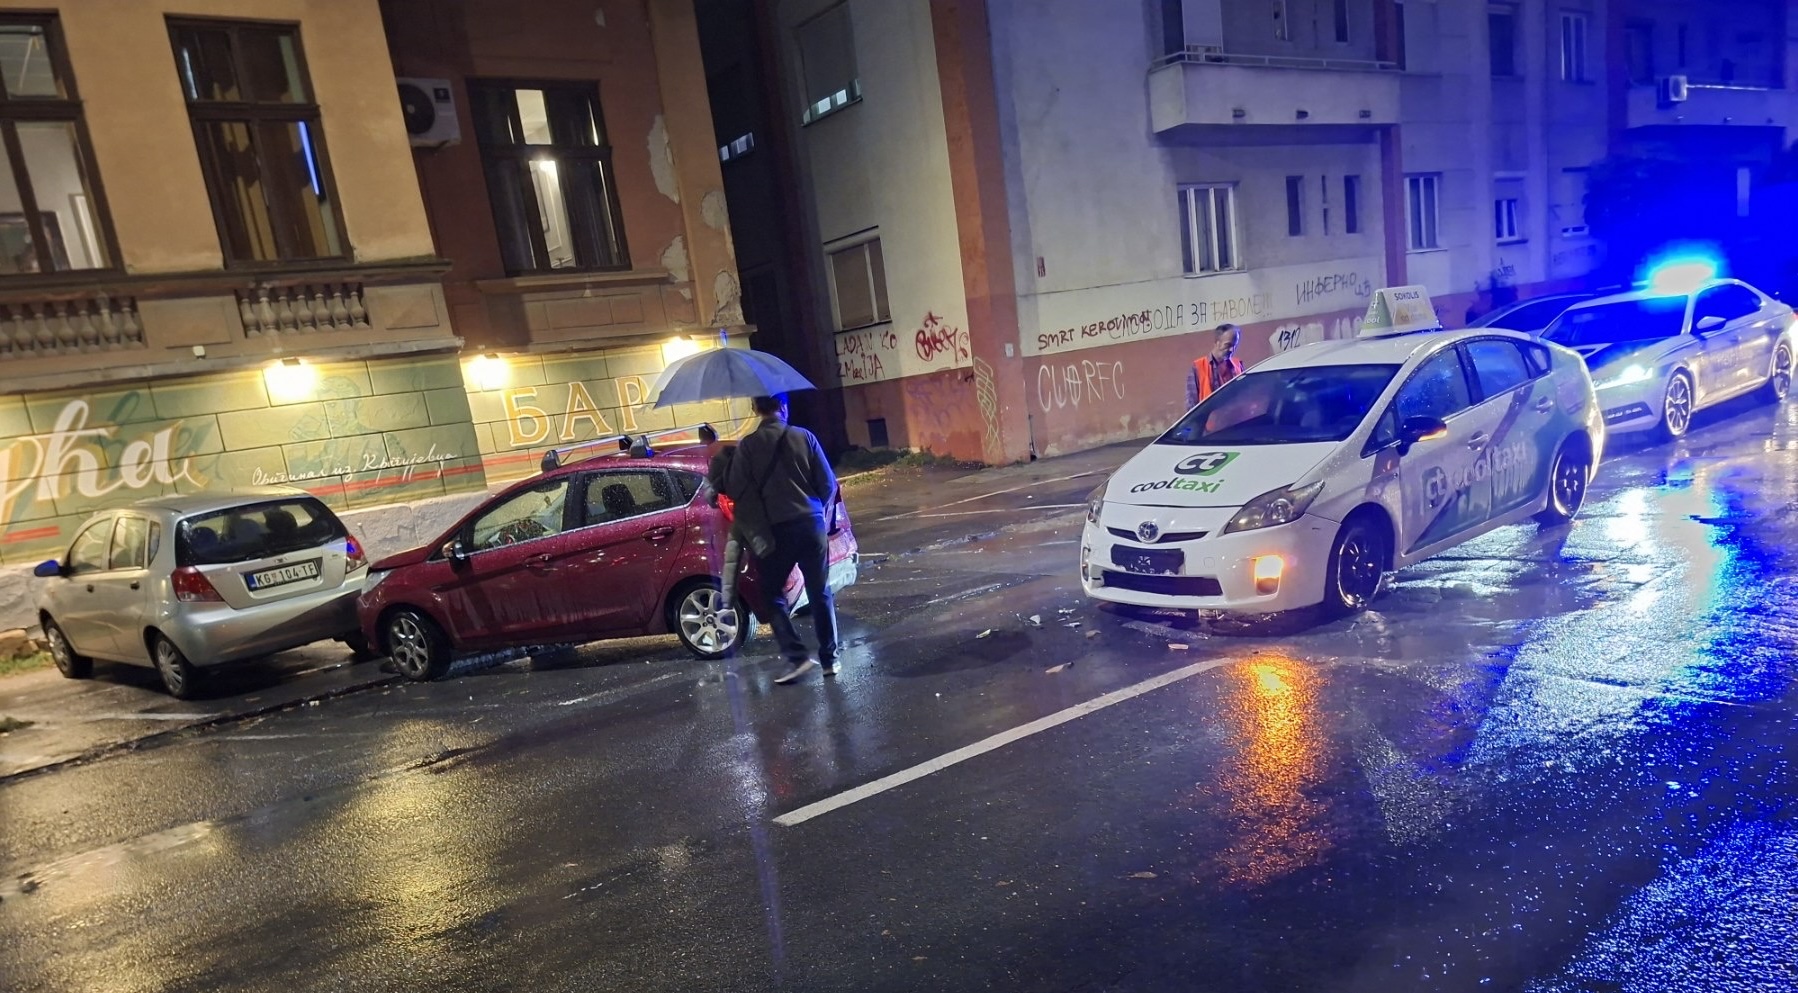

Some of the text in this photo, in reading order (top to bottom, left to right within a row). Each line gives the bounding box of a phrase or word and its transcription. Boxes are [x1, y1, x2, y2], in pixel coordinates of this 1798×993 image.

[1191, 302, 1207, 326] ЗА
[1038, 328, 1075, 351] SMRT
[1277, 326, 1301, 351] 1312
[502, 375, 651, 447] БАР
[1130, 477, 1225, 493] cooltaxi
[256, 573, 271, 586] KG
